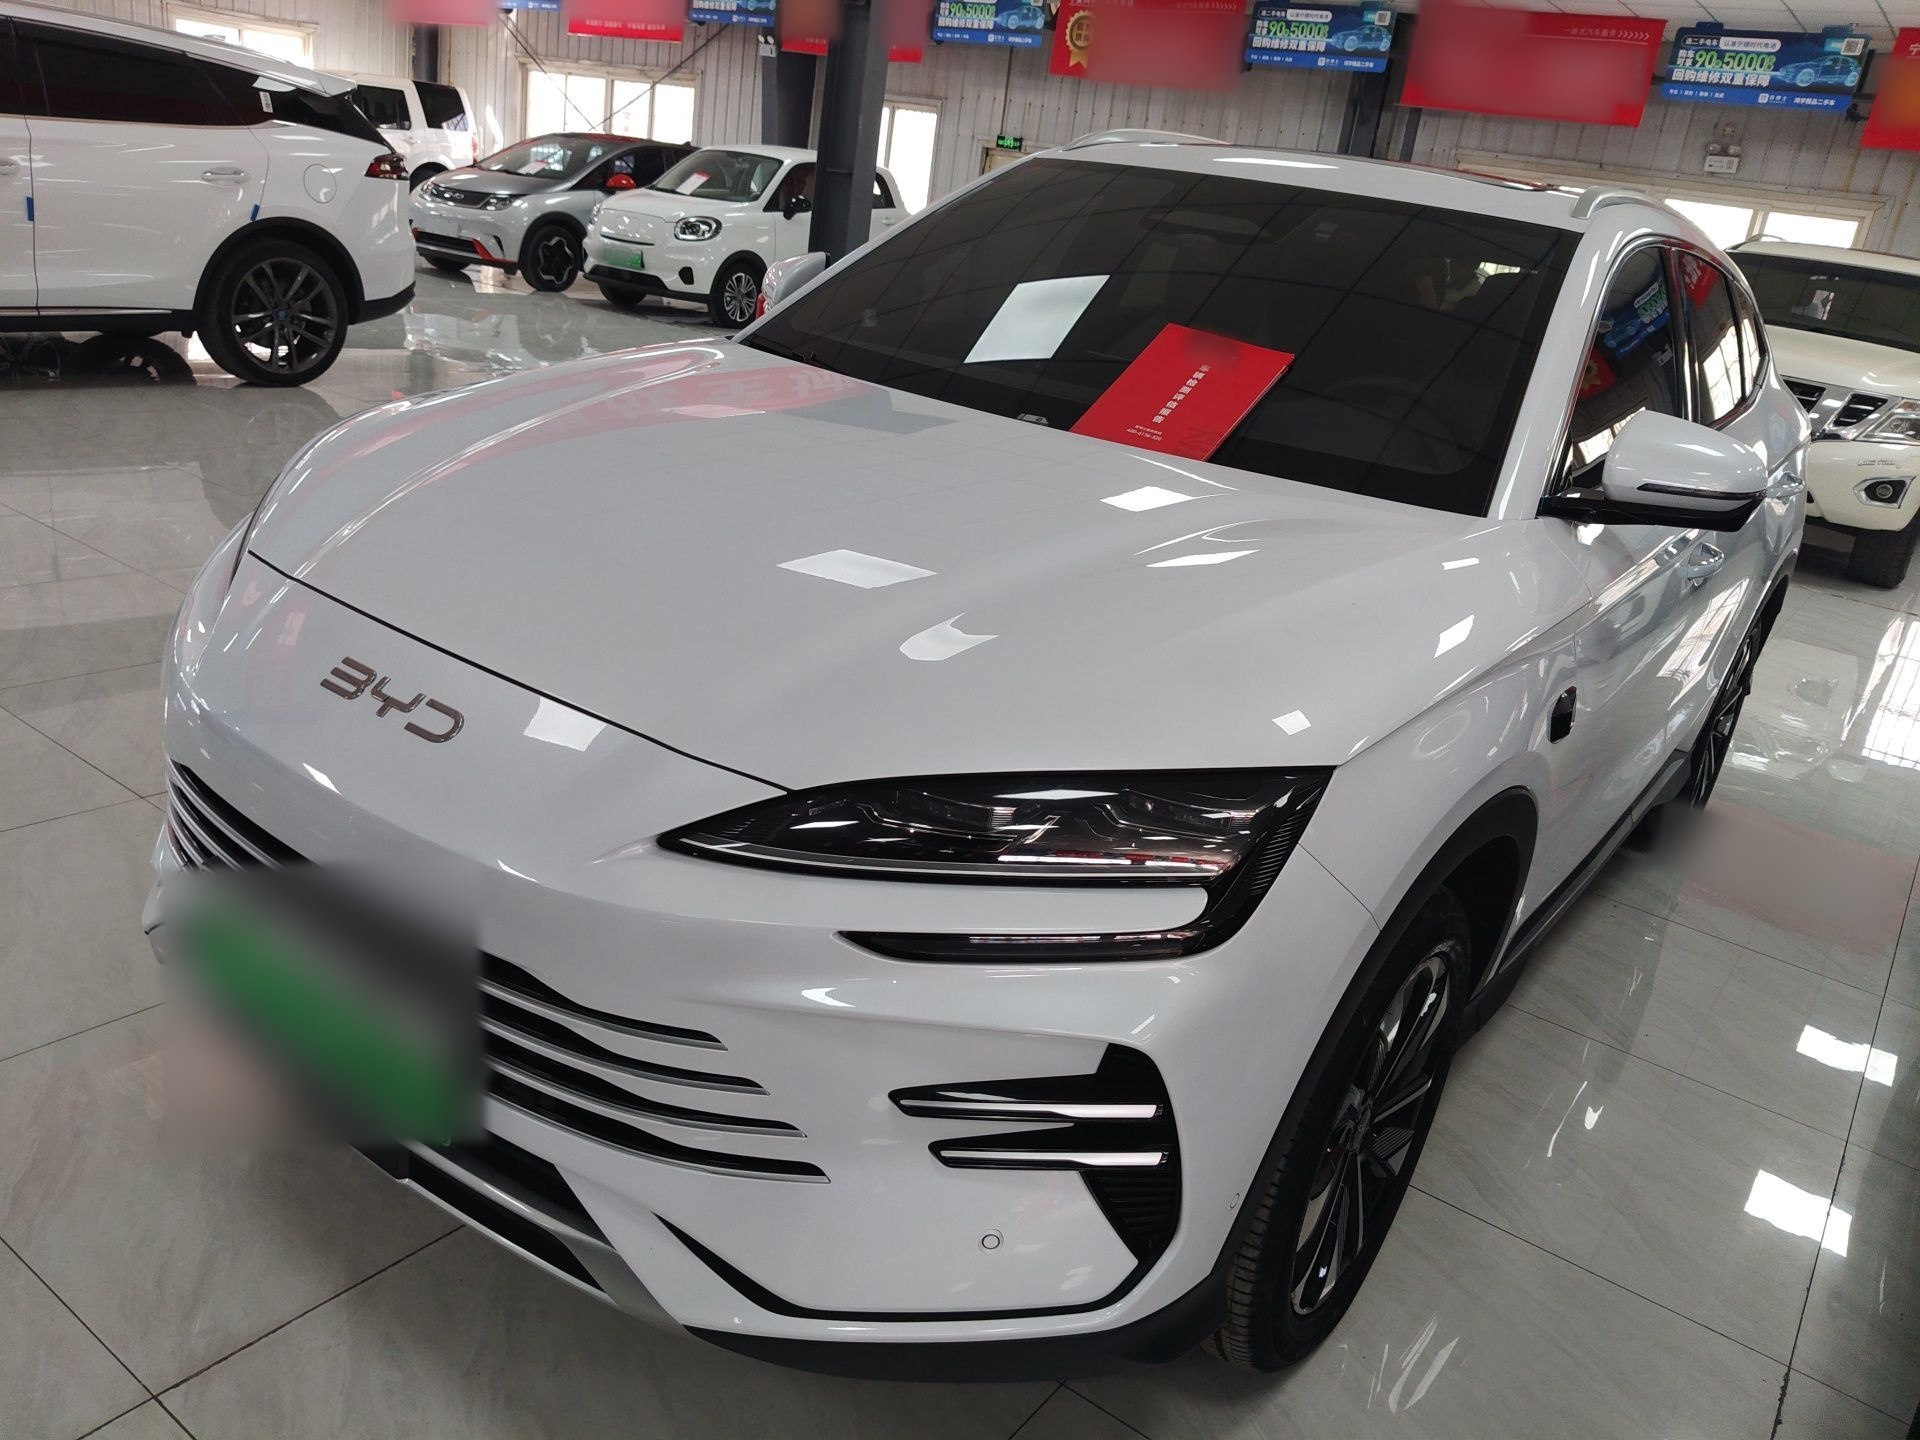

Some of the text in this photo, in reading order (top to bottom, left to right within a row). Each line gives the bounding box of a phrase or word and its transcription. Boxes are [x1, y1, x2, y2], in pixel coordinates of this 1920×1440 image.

[1672, 69, 1771, 88] 回购维修双重保障
[320, 656, 464, 744] BYD
